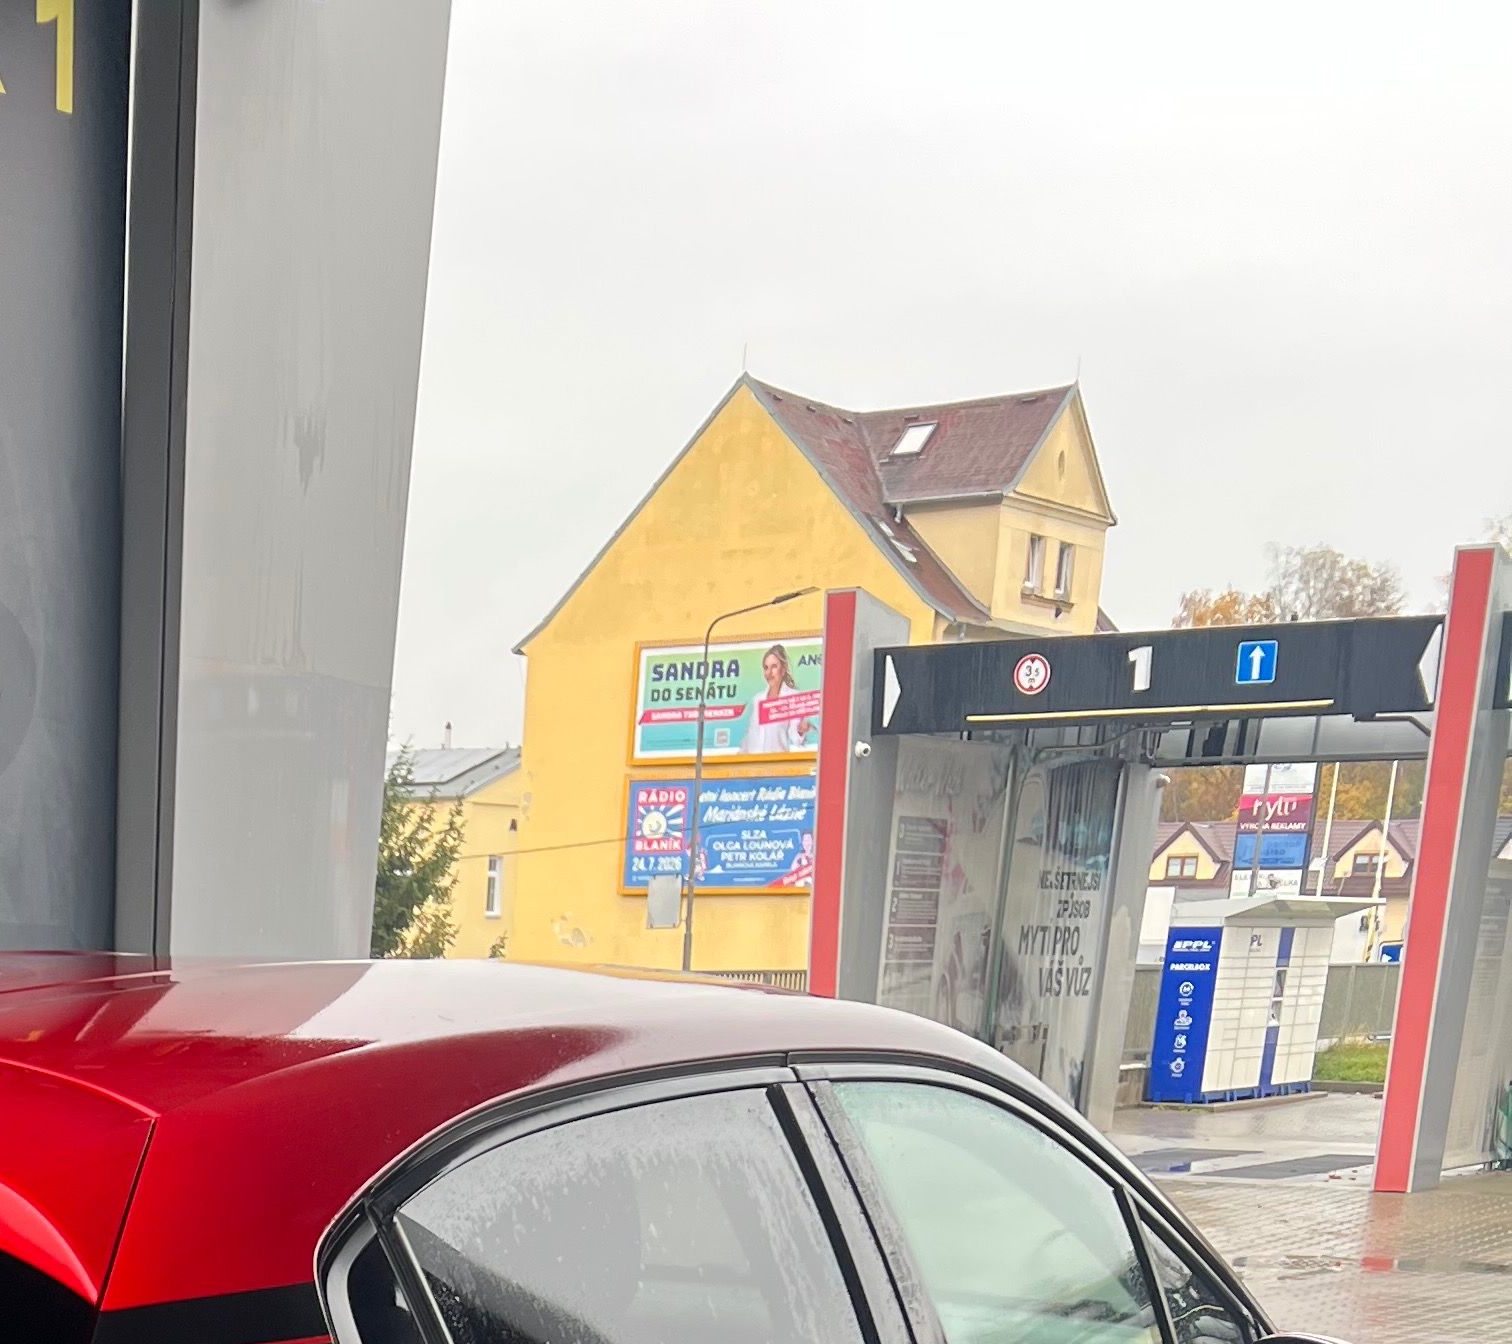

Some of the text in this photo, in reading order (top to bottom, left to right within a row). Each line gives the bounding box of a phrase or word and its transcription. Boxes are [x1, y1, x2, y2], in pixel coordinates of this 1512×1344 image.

[36, 0, 74, 114] 1
[651, 658, 740, 682] SANDRA
[1128, 645, 1153, 691] 1
[651, 682, 737, 703] DO SENÁTU
[638, 788, 686, 803] RÁDIO
[634, 837, 682, 851] BLANÍK
[1052, 925, 1080, 956] PRO
[1039, 954, 1092, 998] VÁŠ VŮZ
